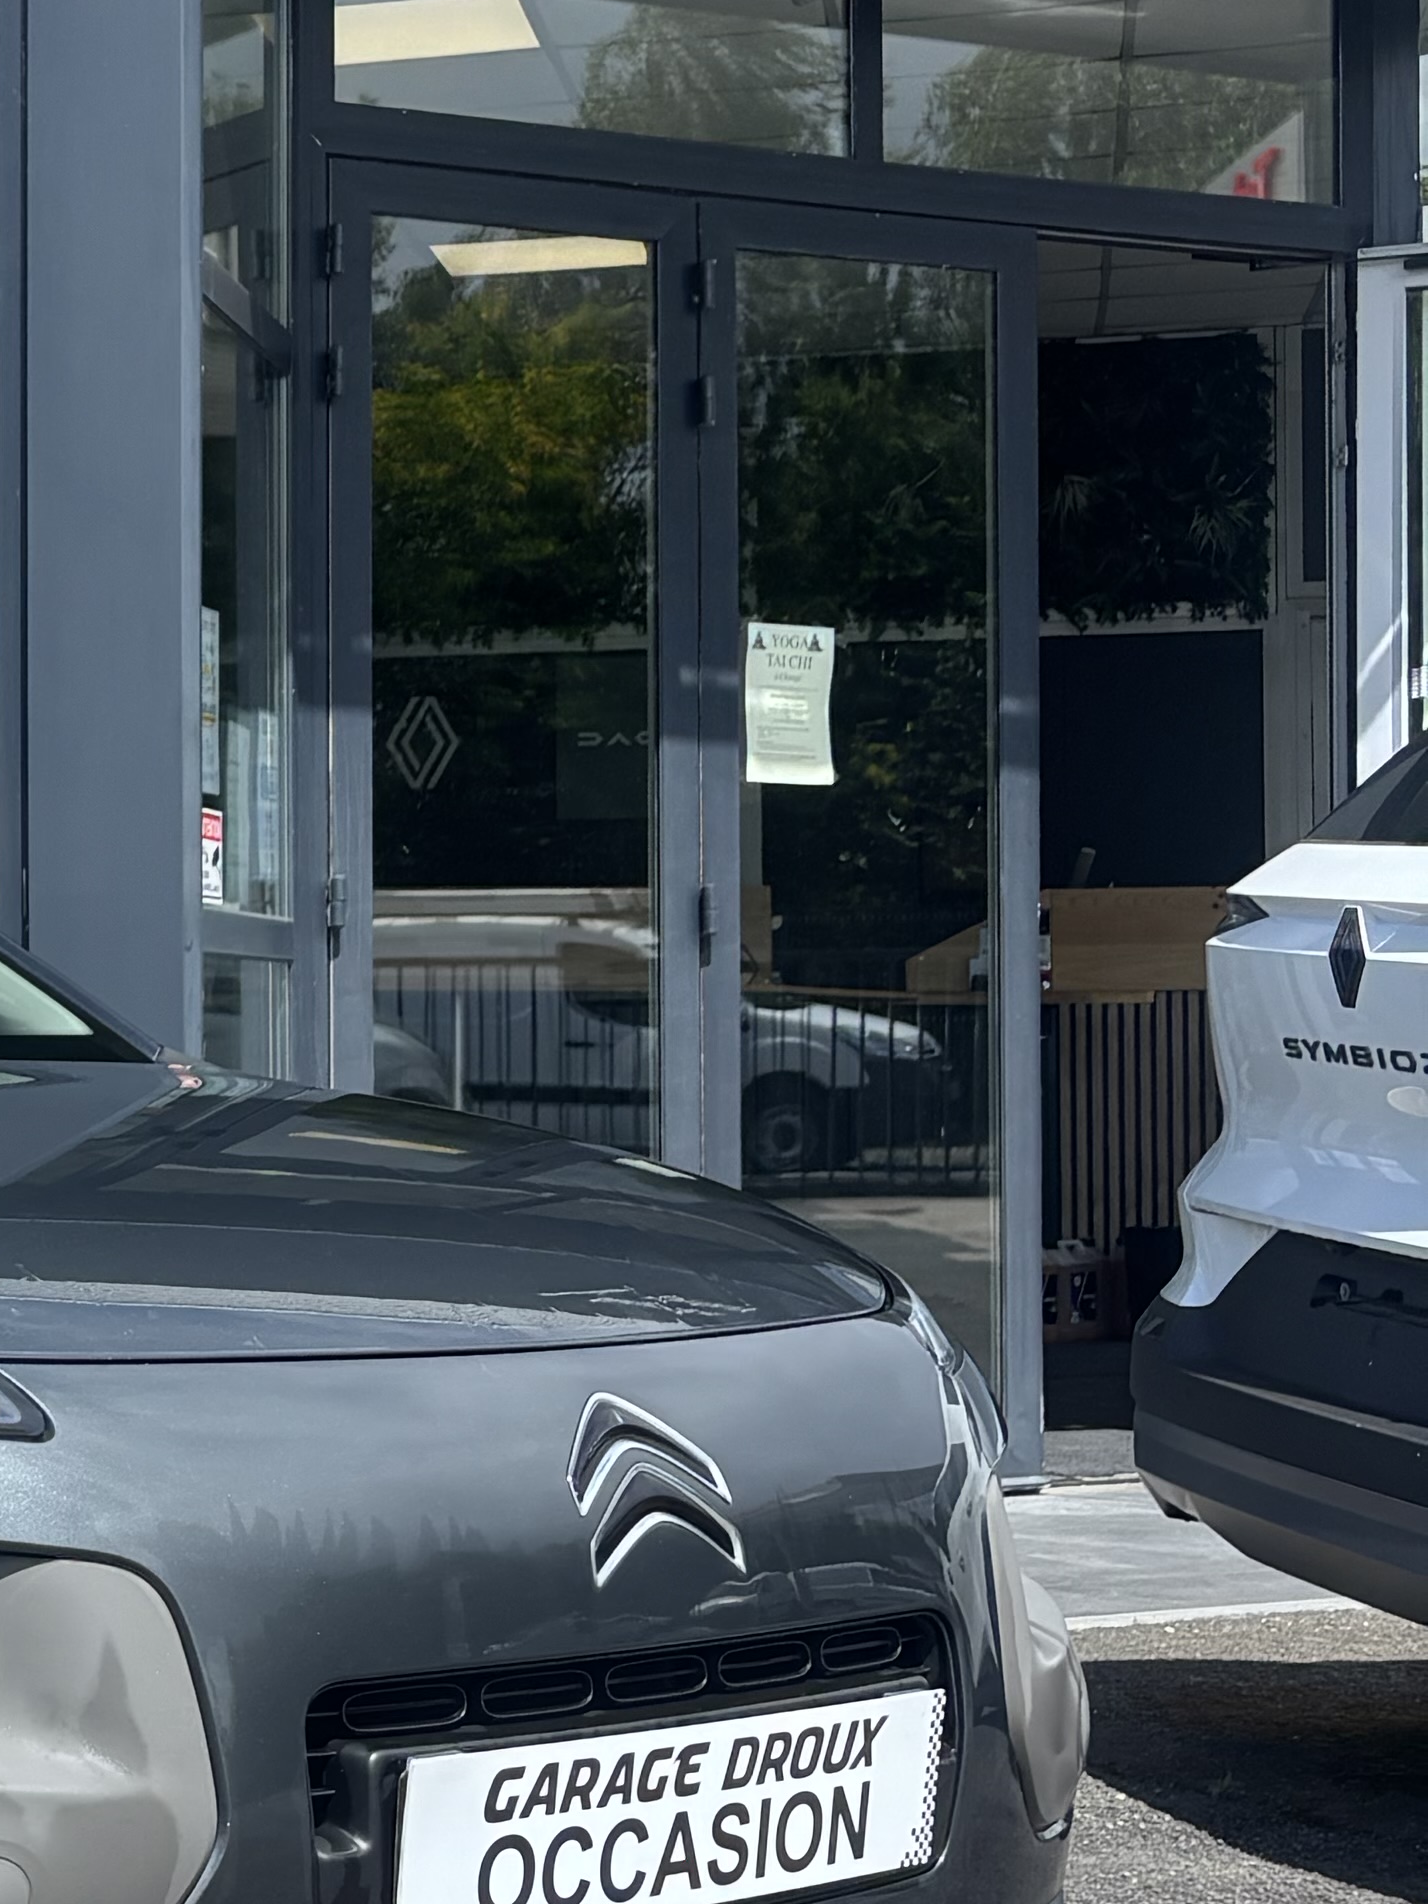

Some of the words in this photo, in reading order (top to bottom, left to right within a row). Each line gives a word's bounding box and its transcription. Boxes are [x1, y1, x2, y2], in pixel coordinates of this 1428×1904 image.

[772, 633, 809, 650] YOGA
[484, 1741, 710, 1823] GARAGE
[720, 1716, 888, 1790] DROUX
